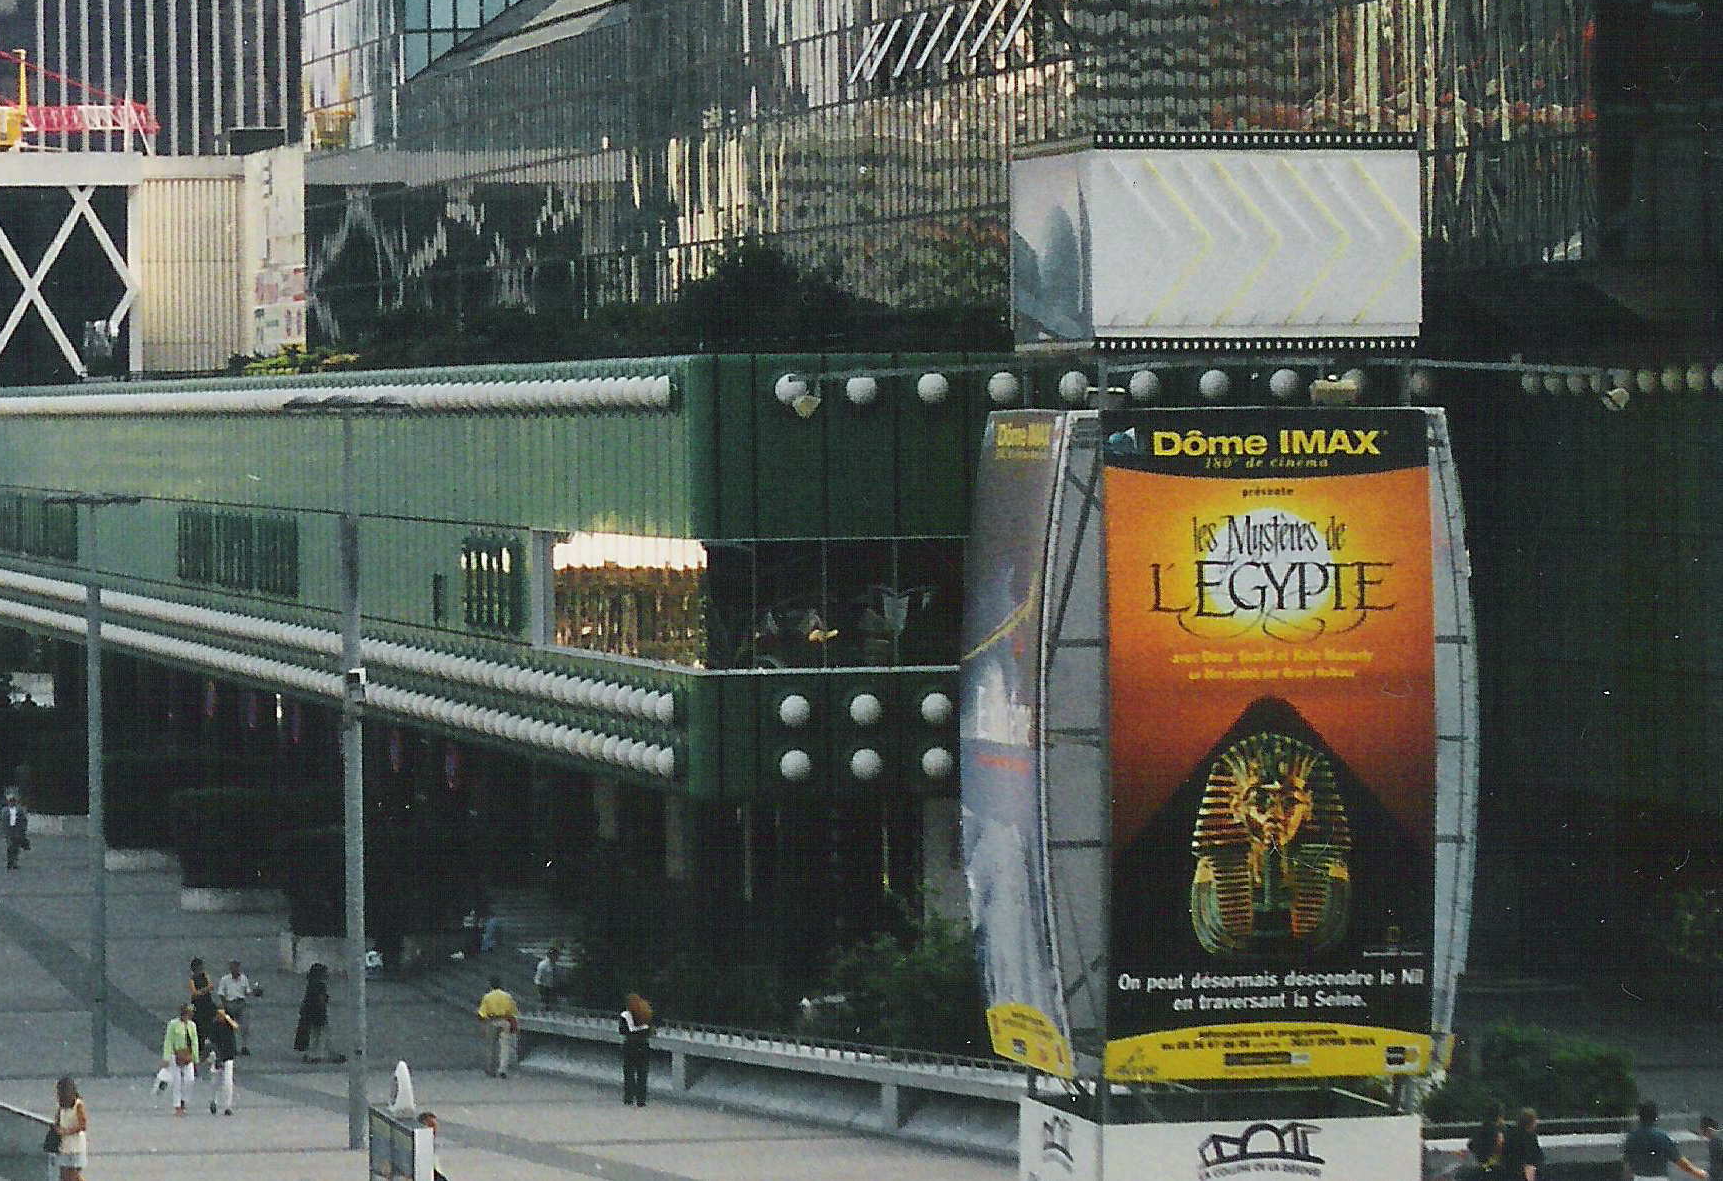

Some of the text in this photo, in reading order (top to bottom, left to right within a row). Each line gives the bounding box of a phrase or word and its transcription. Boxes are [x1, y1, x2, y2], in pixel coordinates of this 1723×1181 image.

[1153, 429, 1381, 456] Dôme IMAX
[1245, 456, 1264, 469] de
[1192, 513, 1348, 560] les Mystères de
[1118, 968, 1424, 993] On peut désormais descendre le Nil
[1173, 990, 1368, 1011] en traversant la Seine.
